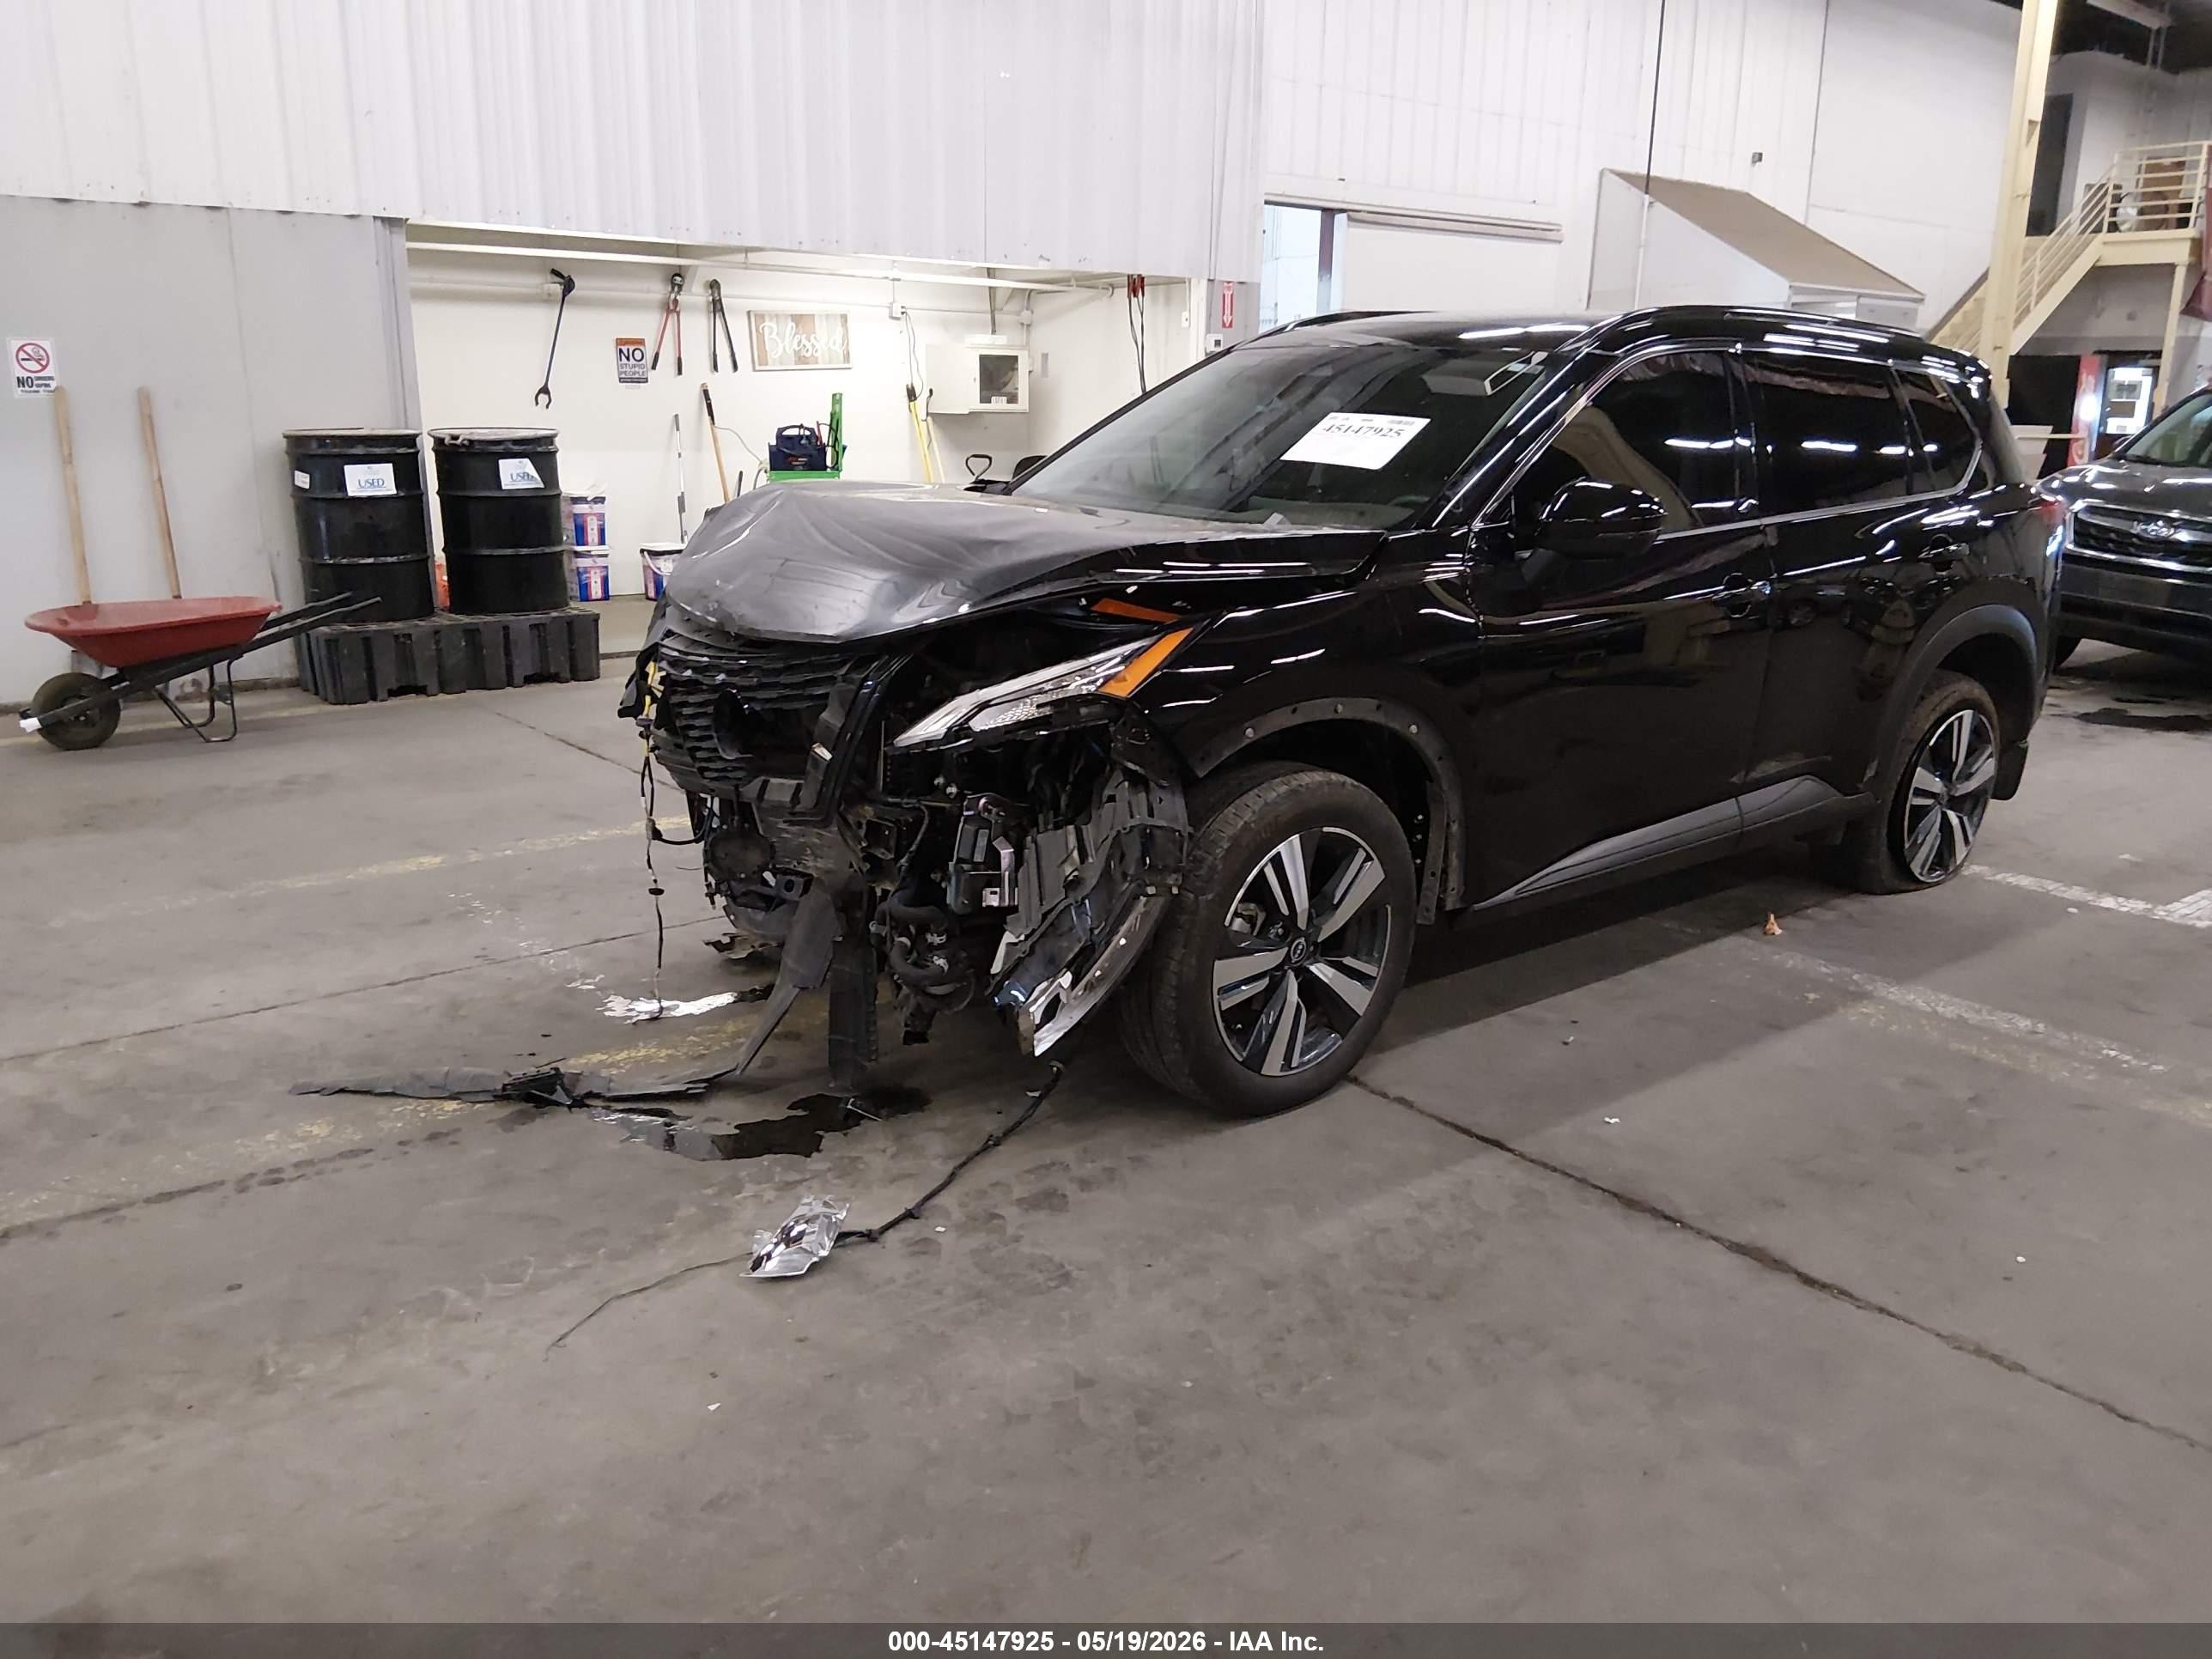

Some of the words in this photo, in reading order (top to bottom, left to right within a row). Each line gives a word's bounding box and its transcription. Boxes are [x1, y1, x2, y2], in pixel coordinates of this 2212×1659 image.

[759, 322, 848, 358] Blessed
[618, 348, 645, 362] NO
[16, 376, 34, 388] NO
[1322, 424, 1406, 438] 45147925
[358, 478, 385, 489] USED
